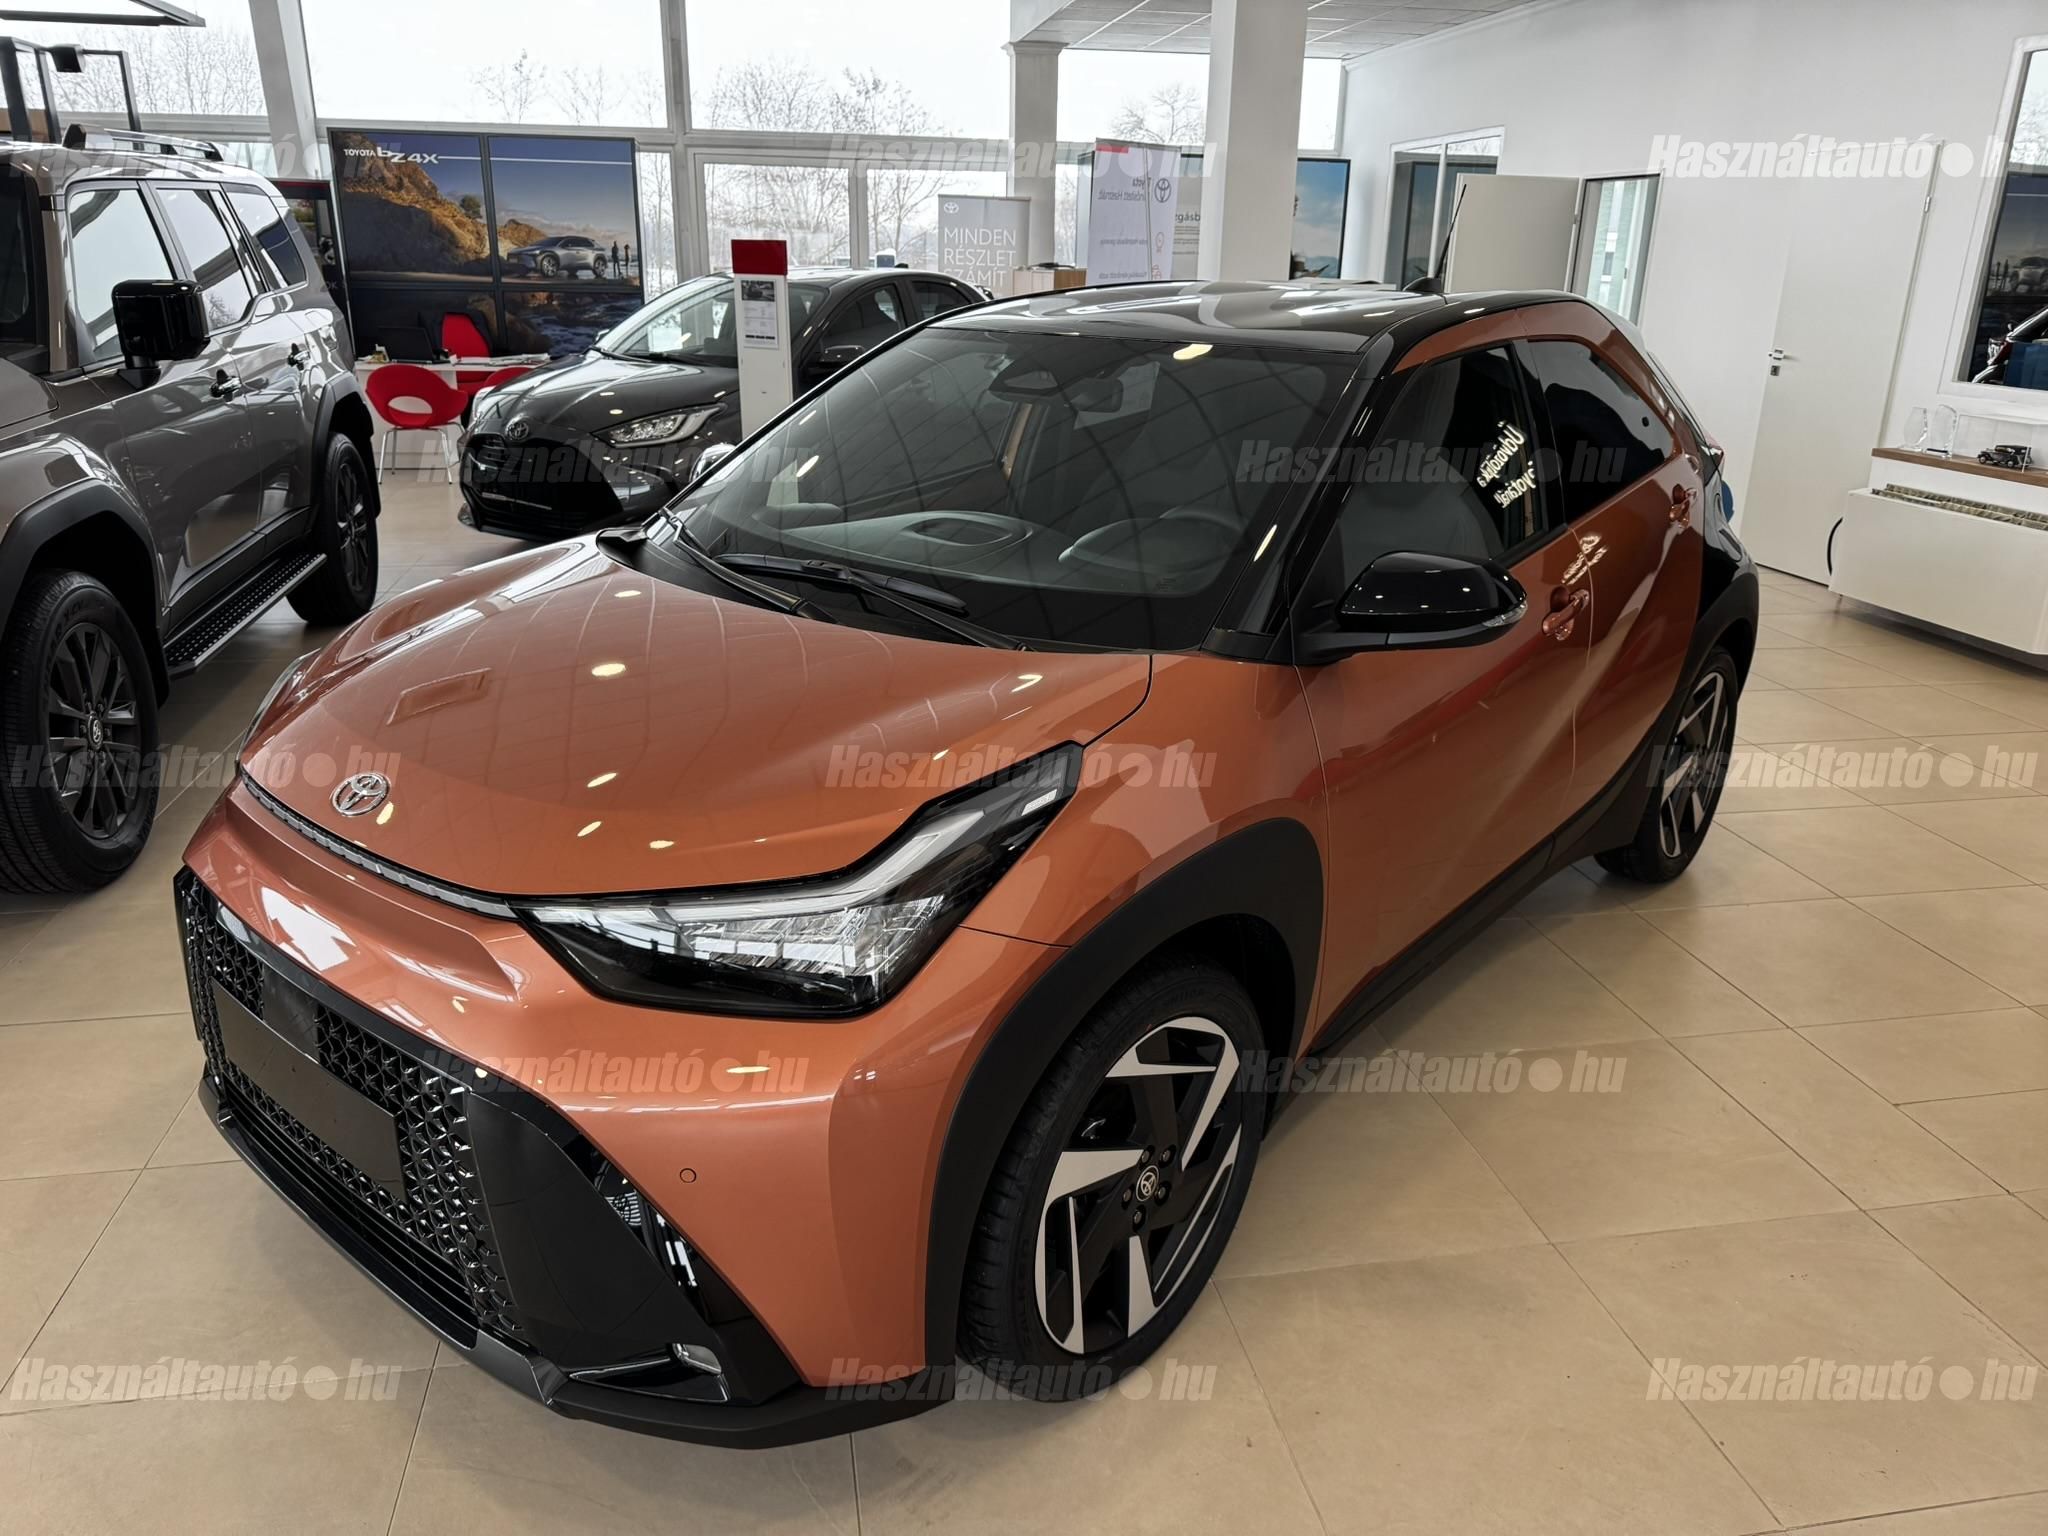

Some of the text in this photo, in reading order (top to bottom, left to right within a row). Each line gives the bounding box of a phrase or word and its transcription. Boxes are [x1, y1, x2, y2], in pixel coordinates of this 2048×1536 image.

[343, 148, 376, 157] TOYOTA
[944, 227, 1016, 246] MINDEN
[943, 244, 1017, 267] RÉSZLET
